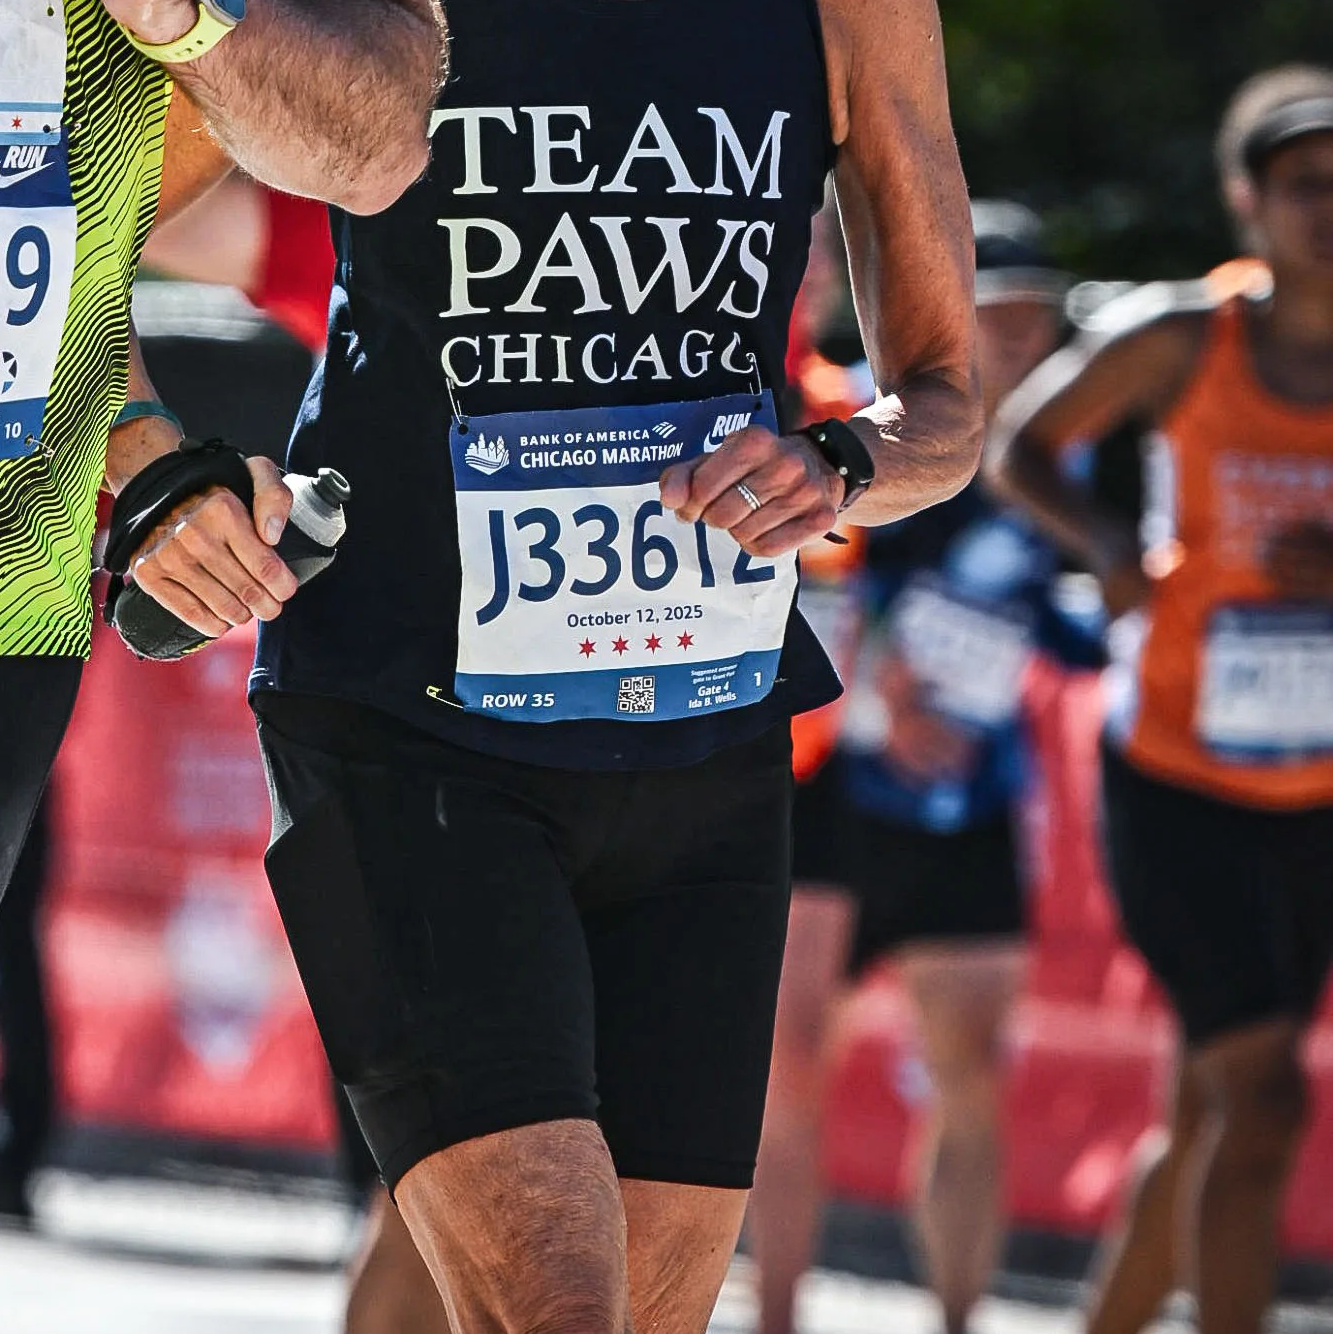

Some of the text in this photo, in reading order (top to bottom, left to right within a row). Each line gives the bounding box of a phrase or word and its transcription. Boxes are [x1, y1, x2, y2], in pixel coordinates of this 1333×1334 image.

[3, 146, 47, 168] RUN
[426, 103, 791, 198] TEAM
[437, 212, 775, 318] PAWS
[5, 422, 22, 439] 10
[711, 412, 752, 438] RUN
[520, 429, 650, 446] BANK OF AMERICA
[520, 442, 684, 468] CHICAGO MARATHON
[567, 604, 703, 628] October 12, 2025
[754, 671, 761, 686] 1
[698, 681, 729, 696] Gate 4
[482, 693, 555, 708] ROW 35
[689, 692, 737, 709] Ida B. Wells
